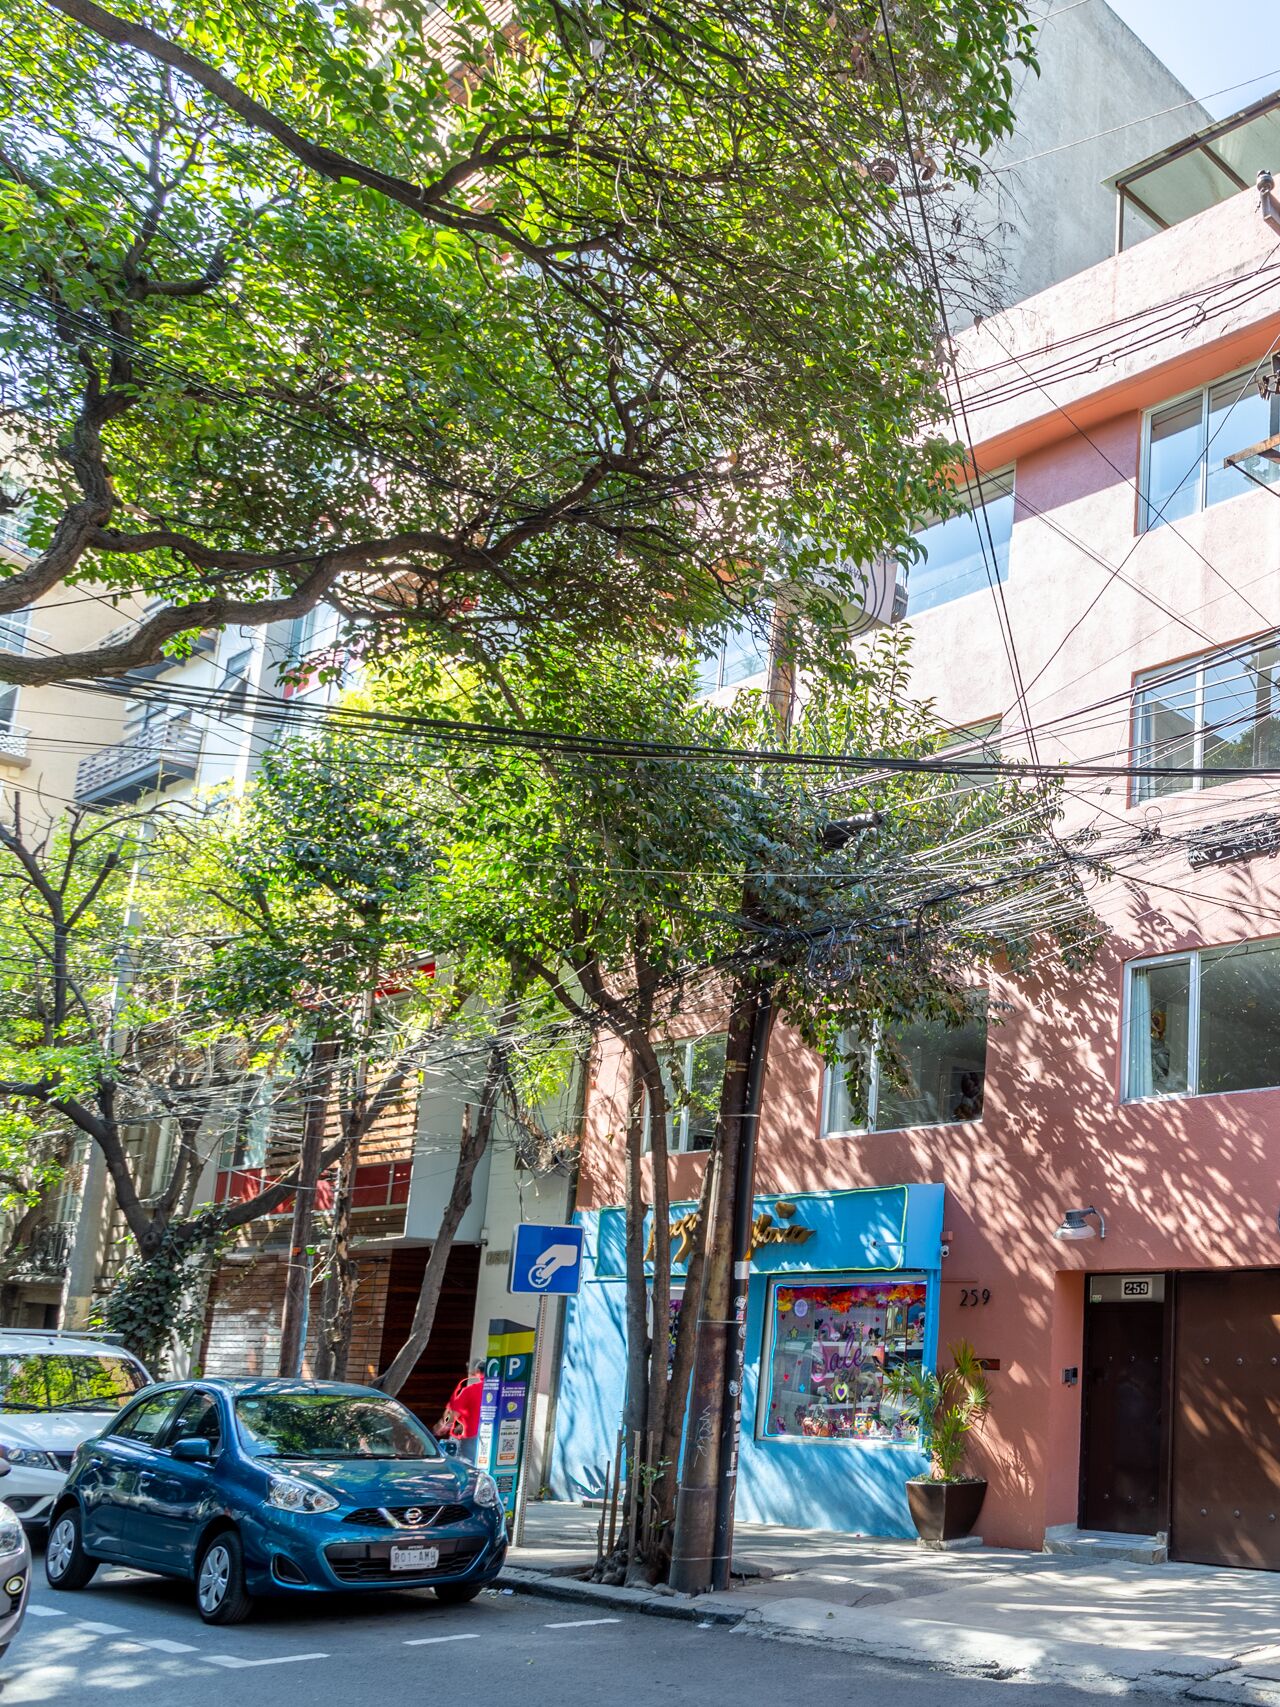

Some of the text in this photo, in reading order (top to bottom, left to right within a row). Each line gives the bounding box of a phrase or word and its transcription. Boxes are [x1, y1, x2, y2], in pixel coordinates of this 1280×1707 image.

[960, 1288, 991, 1306] 259
[1125, 1282, 1148, 1294] 259
[812, 1323, 866, 1383] Sale
[508, 1357, 521, 1376] P
